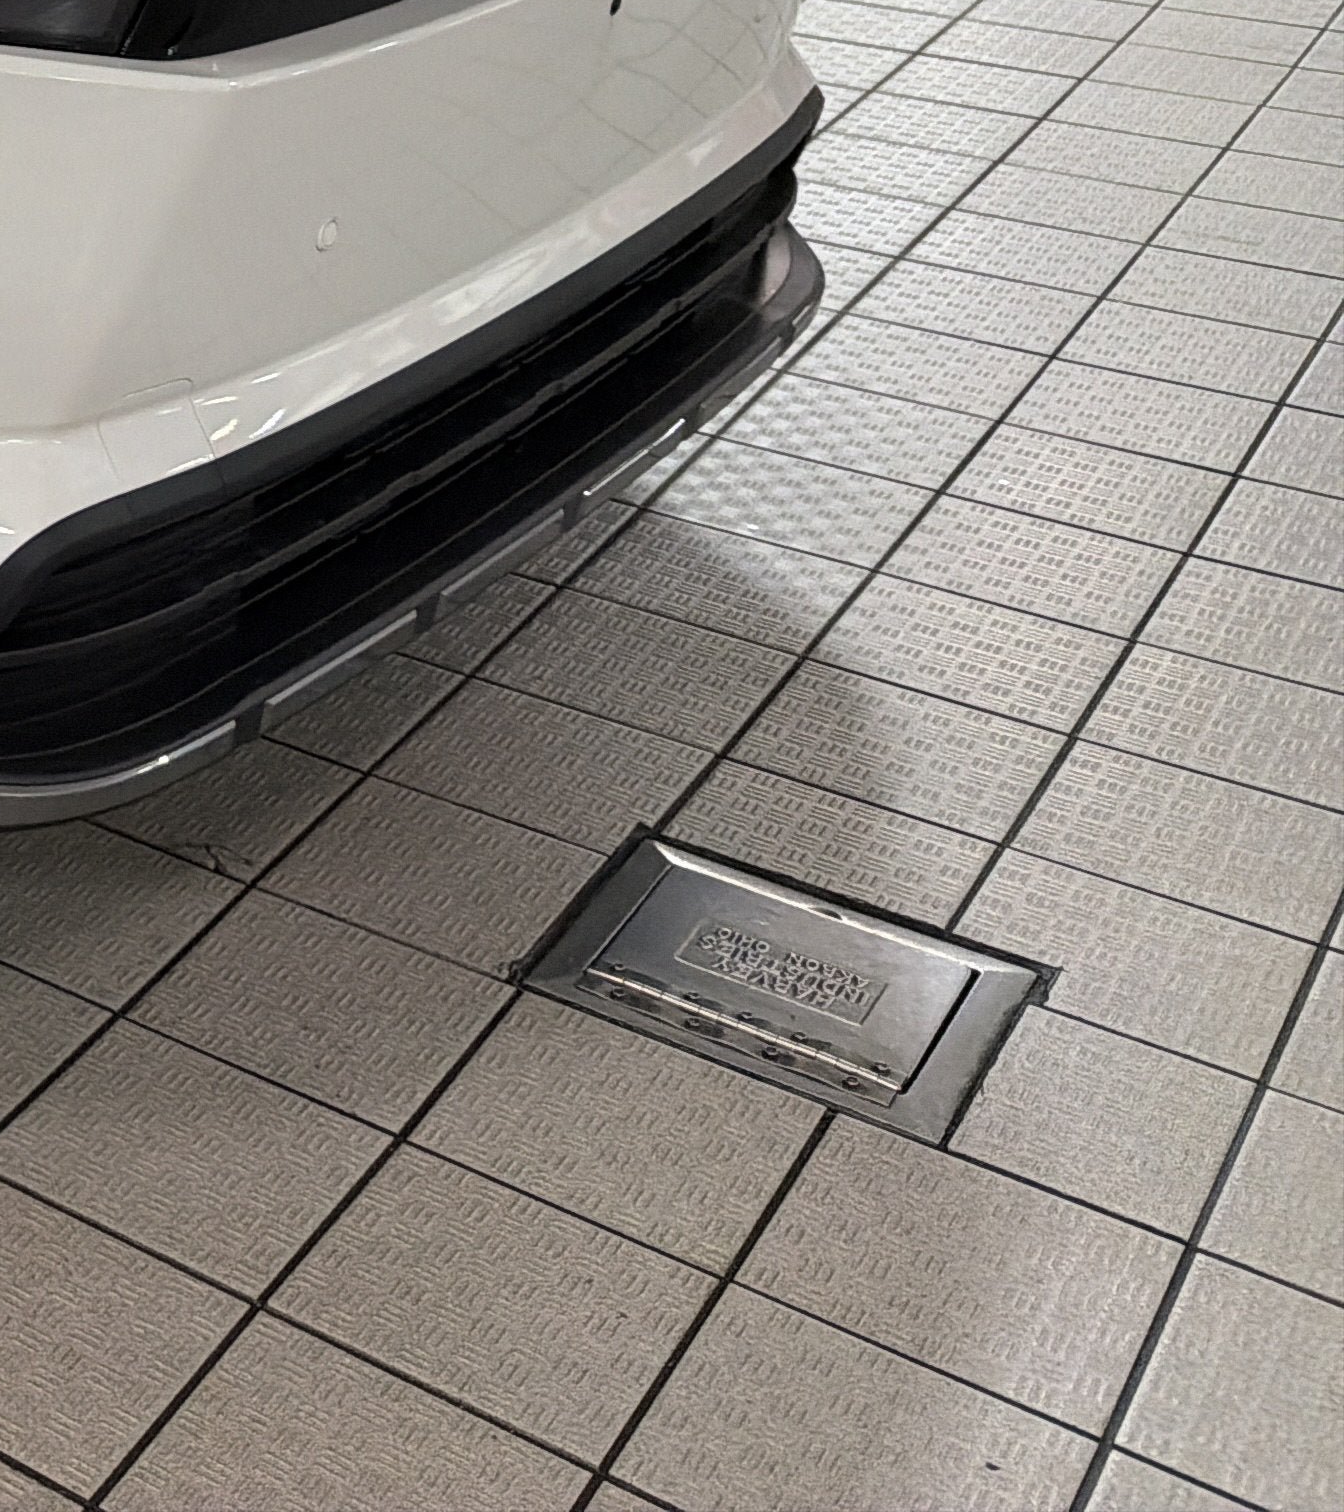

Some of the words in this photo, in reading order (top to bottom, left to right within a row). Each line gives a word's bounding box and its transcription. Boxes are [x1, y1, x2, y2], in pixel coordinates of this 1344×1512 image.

[717, 926, 772, 954] OHIO
[698, 935, 869, 1006] INDUSTRIES
[712, 956, 838, 1009] HARVEY
[785, 951, 871, 989] AKRON
